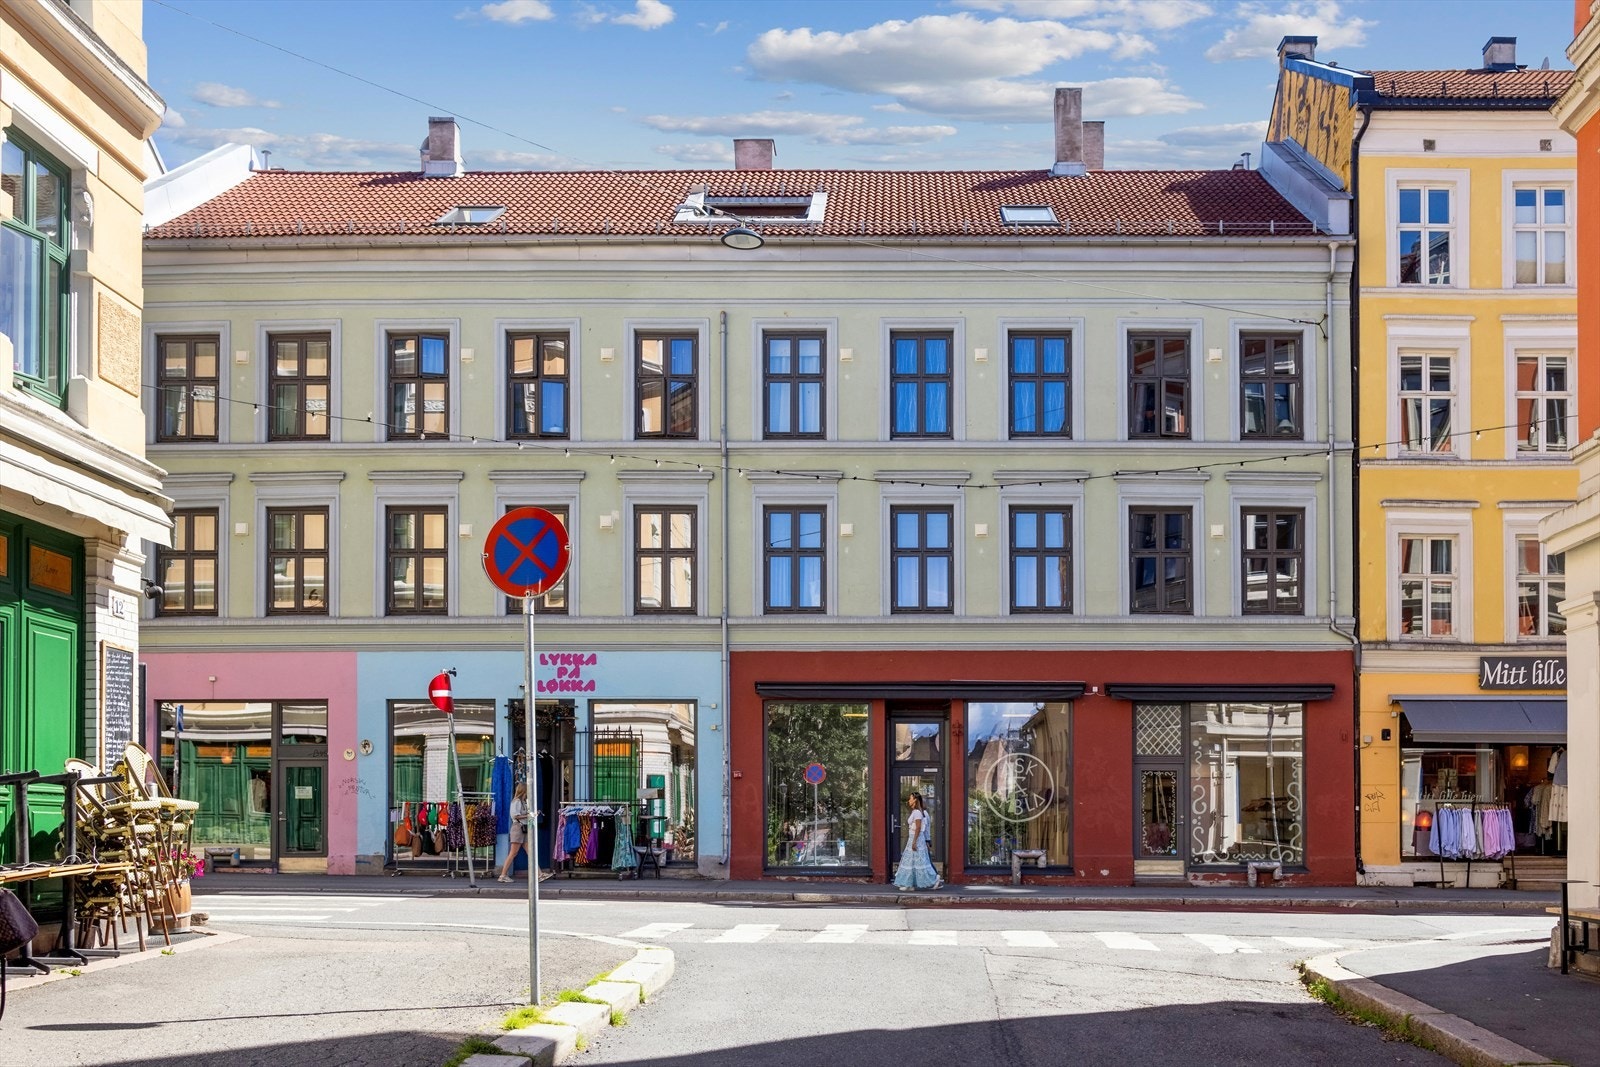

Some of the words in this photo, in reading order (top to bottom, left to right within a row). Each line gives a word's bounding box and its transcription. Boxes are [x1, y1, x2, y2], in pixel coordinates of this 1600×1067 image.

[115, 600, 124, 615] 12
[540, 653, 597, 665] LYKKA
[557, 664, 580, 679] PÅ
[1481, 660, 1527, 686] Mitt
[1532, 660, 1566, 685] lille
[537, 679, 596, 694] LØKKA
